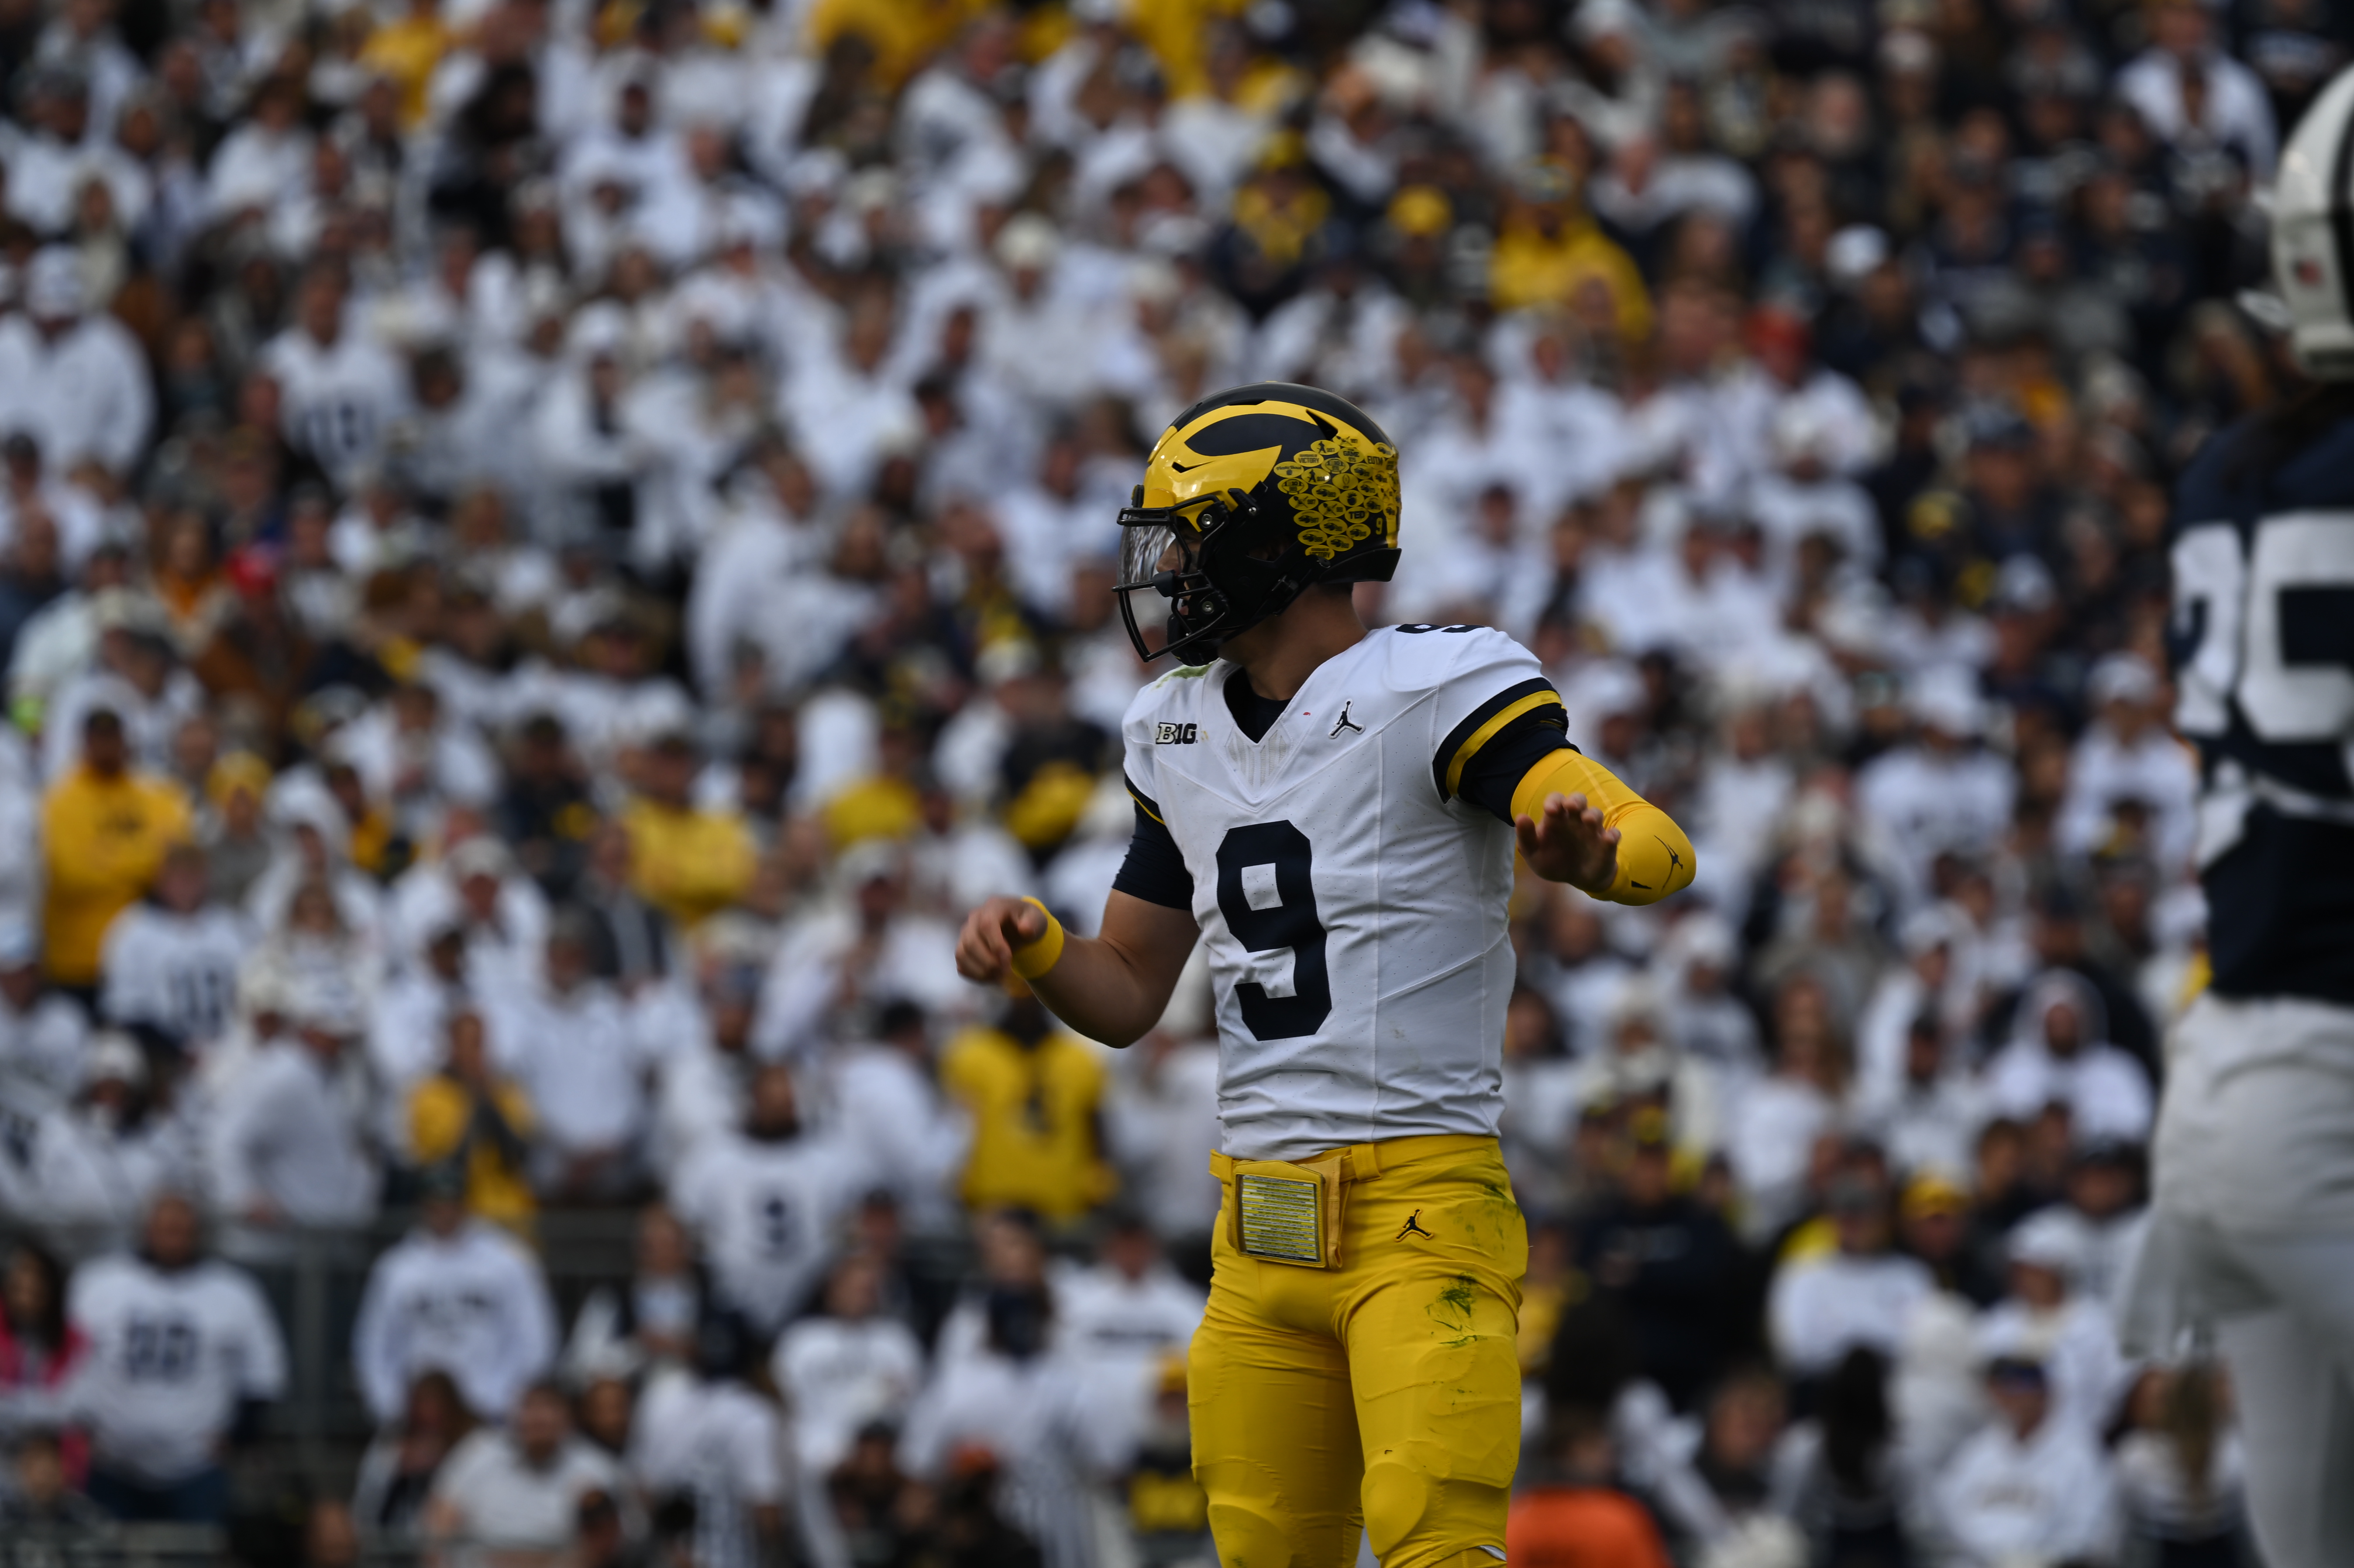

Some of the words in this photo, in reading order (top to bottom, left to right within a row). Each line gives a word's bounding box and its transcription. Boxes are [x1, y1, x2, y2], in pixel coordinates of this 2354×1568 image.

[1349, 511, 1366, 519] TED
[1376, 517, 1383, 535] 9
[1216, 819, 1332, 1041] 9
